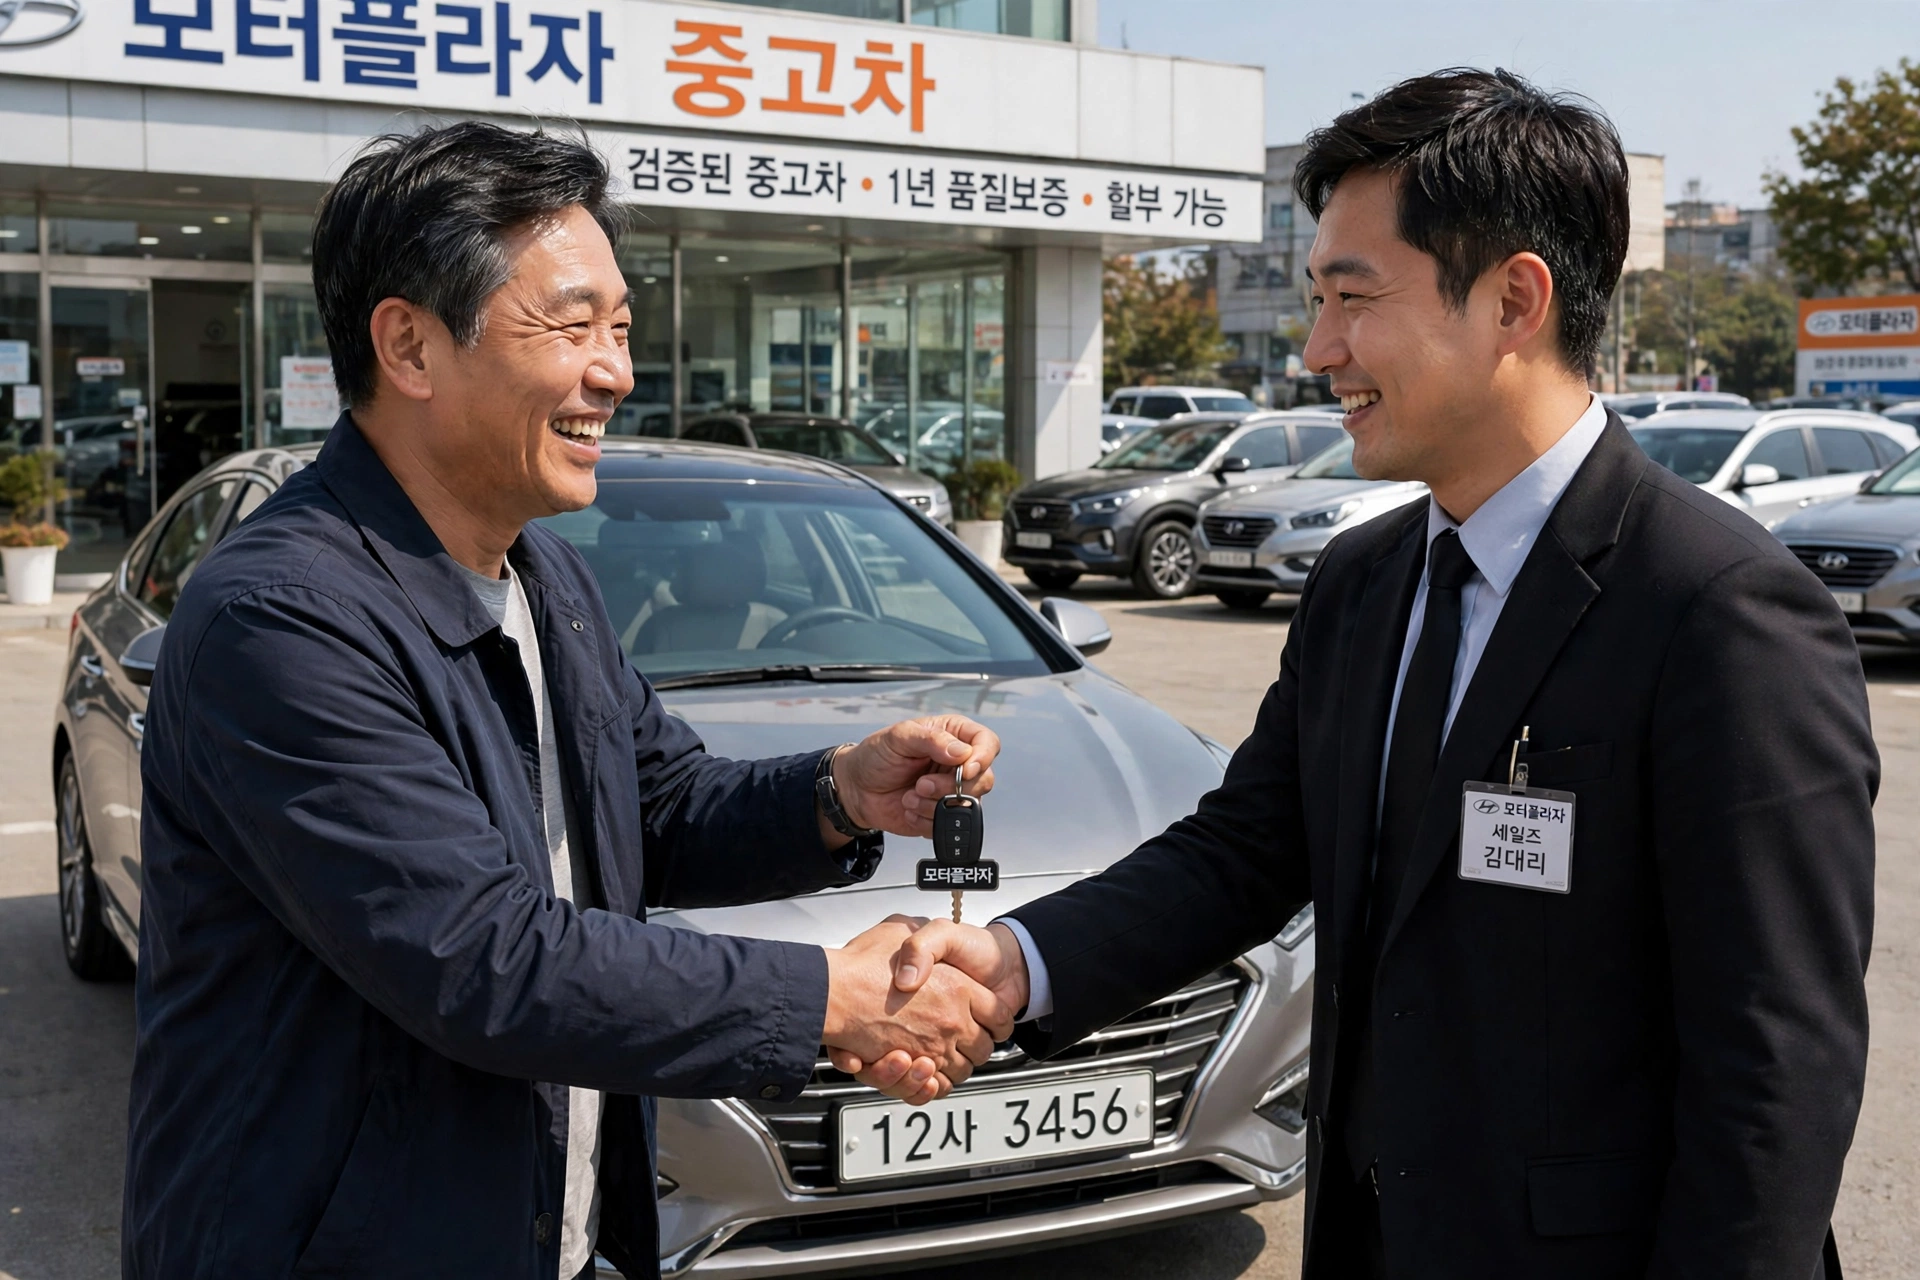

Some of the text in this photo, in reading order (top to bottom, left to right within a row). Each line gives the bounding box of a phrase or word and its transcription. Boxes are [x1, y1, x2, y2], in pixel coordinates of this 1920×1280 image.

[666, 20, 936, 132] 중고차
[627, 148, 1227, 228] 검증된 중고차 1년 품질보증 할부 가능
[1484, 846, 1545, 875] 김대리
[1492, 824, 1541, 844] 세일즈
[923, 867, 993, 884] 모터플라자
[872, 1087, 1128, 1165] 12사 3456
